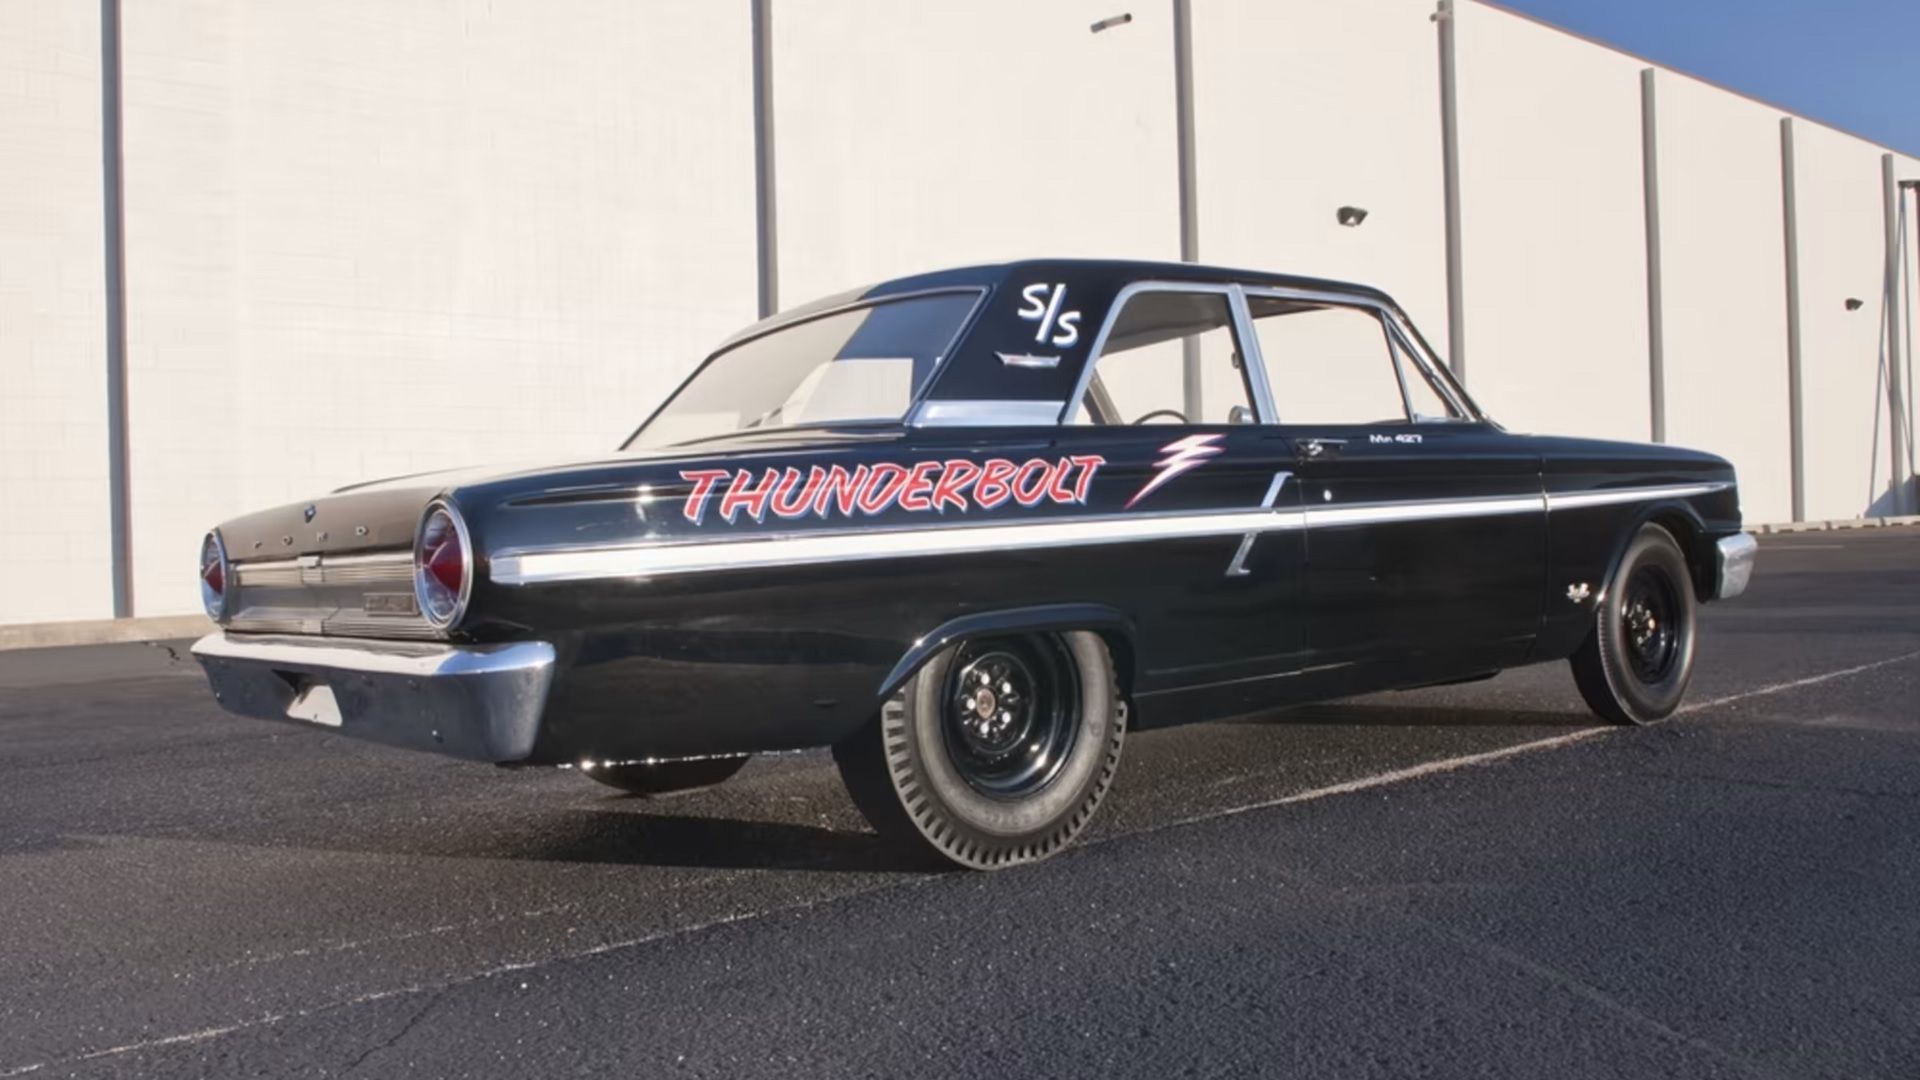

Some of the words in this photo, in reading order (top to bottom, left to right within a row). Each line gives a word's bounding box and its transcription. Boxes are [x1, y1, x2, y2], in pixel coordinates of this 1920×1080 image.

[1017, 283, 1081, 347] S/S
[1395, 433, 1423, 444] 427
[679, 455, 1107, 525] THUNDERBOLT
